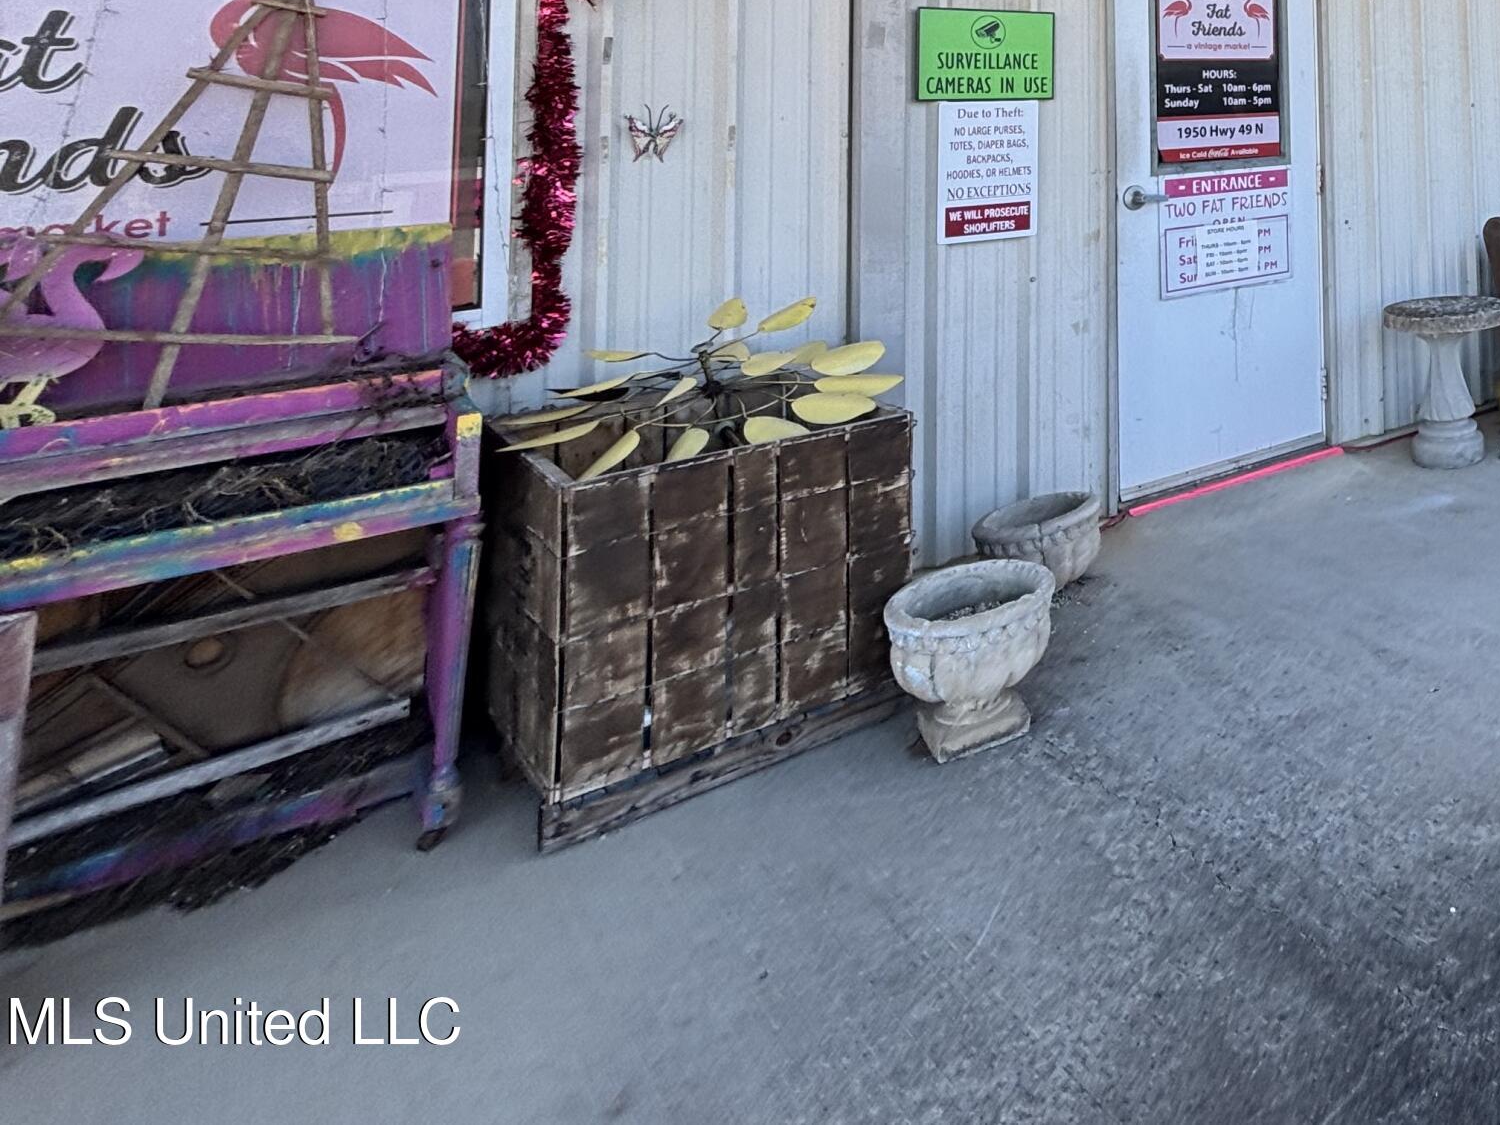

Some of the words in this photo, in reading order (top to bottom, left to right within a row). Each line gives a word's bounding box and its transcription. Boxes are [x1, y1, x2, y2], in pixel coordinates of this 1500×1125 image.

[1206, 4, 1232, 19] Fat
[1191, 21, 1246, 37] Friends
[1194, 43, 1222, 52] vintage
[937, 52, 1038, 70] SURVEILLANCE
[1202, 69, 1238, 79] HOURS:
[926, 77, 992, 94] CAMERAS
[1000, 77, 1015, 93] IN
[1024, 77, 1048, 93] USE
[1164, 84, 1191, 94] Thurs
[1198, 83, 1213, 93] Sat
[1222, 83, 1246, 92] 10am
[1252, 82, 1272, 94] 6pm
[1164, 98, 1200, 109] Sunday
[1222, 96, 1247, 106] 10am
[1252, 95, 1272, 107] 5pm
[957, 108, 979, 119] Due
[981, 109, 992, 118] to
[995, 107, 1024, 118] Theft:
[954, 127, 966, 136] NO
[967, 126, 992, 136] LARGE
[993, 125, 1026, 135] PURSES,
[1177, 125, 1207, 139] 1950
[1209, 124, 1236, 139] Hwy
[1238, 123, 1253, 135] 49
[1255, 122, 1264, 134] N
[950, 141, 976, 151] TOTES,
[977, 140, 1005, 150] DIAPER
[1006, 138, 1029, 150] BAGS,
[966, 153, 1013, 164] BACKPACKS,
[946, 169, 984, 180] HOODIES,
[985, 168, 997, 178] OR
[998, 166, 1032, 176] HELMETS
[1192, 174, 1262, 194] ENTRANCE
[947, 187, 965, 200] NO
[967, 183, 1032, 198] EXCEPTIONS
[1164, 201, 1197, 219] TWO
[1202, 198, 1226, 215] FAT
[1231, 192, 1288, 211] FRIENDS
[949, 211, 962, 222] WE
[963, 210, 983, 220] WILL
[984, 205, 1029, 218] PROSECUTE
[963, 220, 1016, 234] SHOPLIFTERS
[1264, 261, 1278, 270] PM
